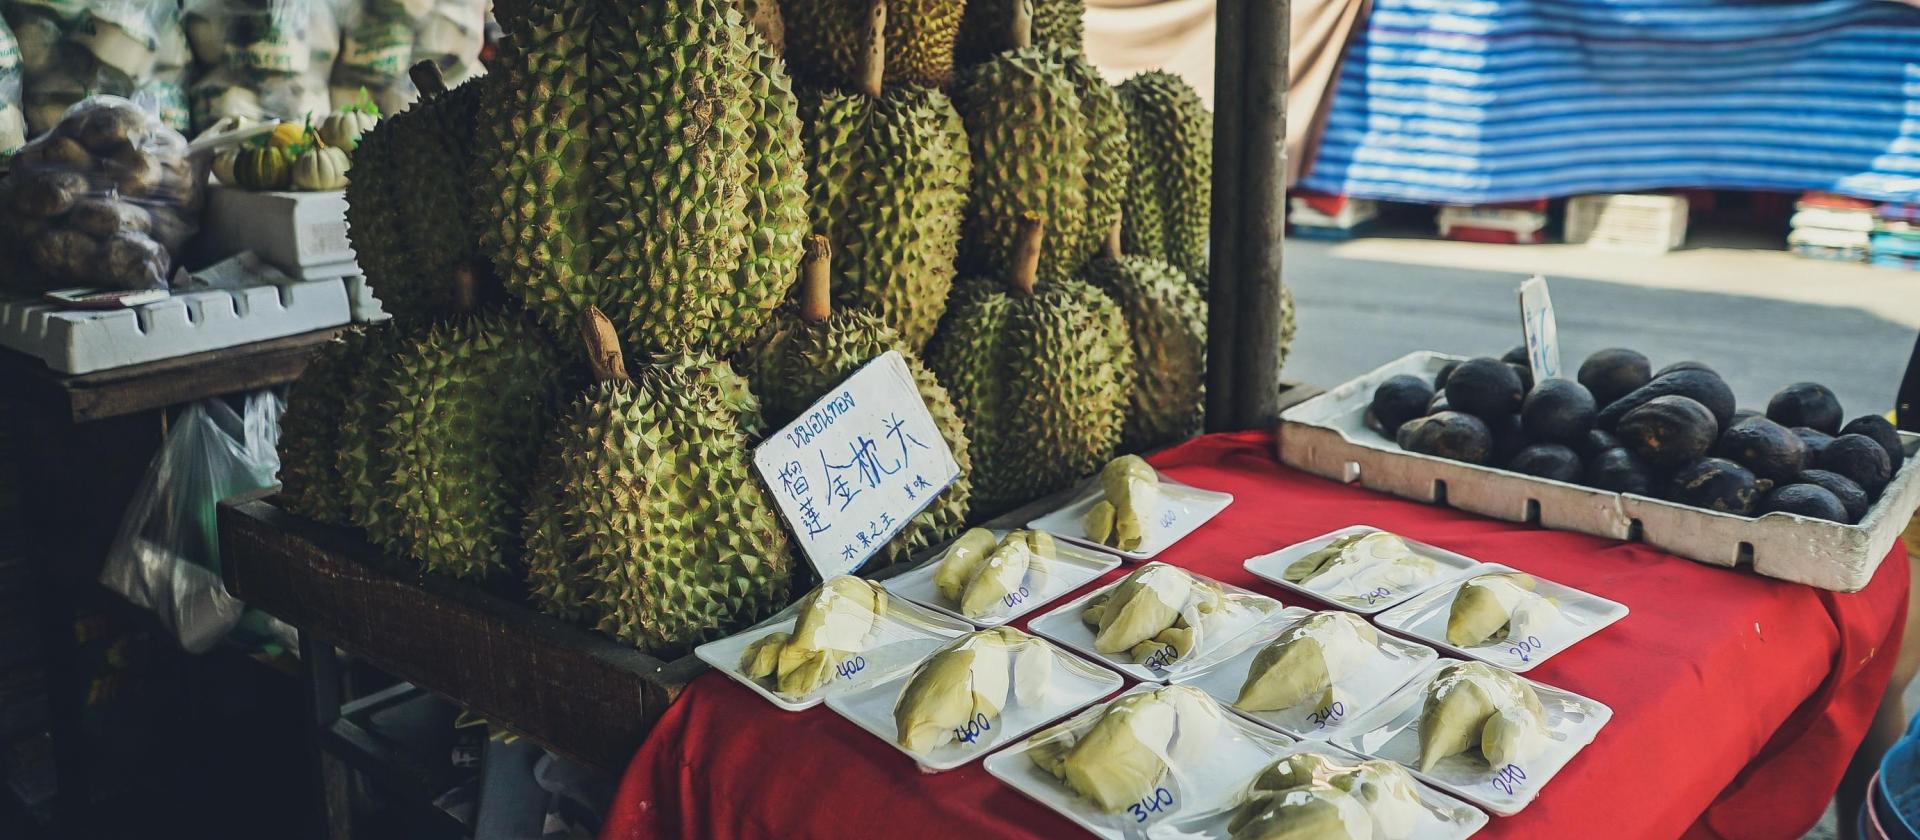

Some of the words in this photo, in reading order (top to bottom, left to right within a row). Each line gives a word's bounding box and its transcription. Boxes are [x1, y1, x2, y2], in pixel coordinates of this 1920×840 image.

[786, 391, 856, 449] หมอนทอง
[819, 412, 931, 512] 金枕头
[1003, 586, 1030, 608] 400
[1359, 586, 1391, 605] 240
[836, 656, 866, 680] 400
[1145, 644, 1179, 672] 370
[954, 712, 991, 744] 400
[1305, 701, 1344, 730] 340
[1492, 763, 1527, 796] 240
[1126, 787, 1173, 823] 340
